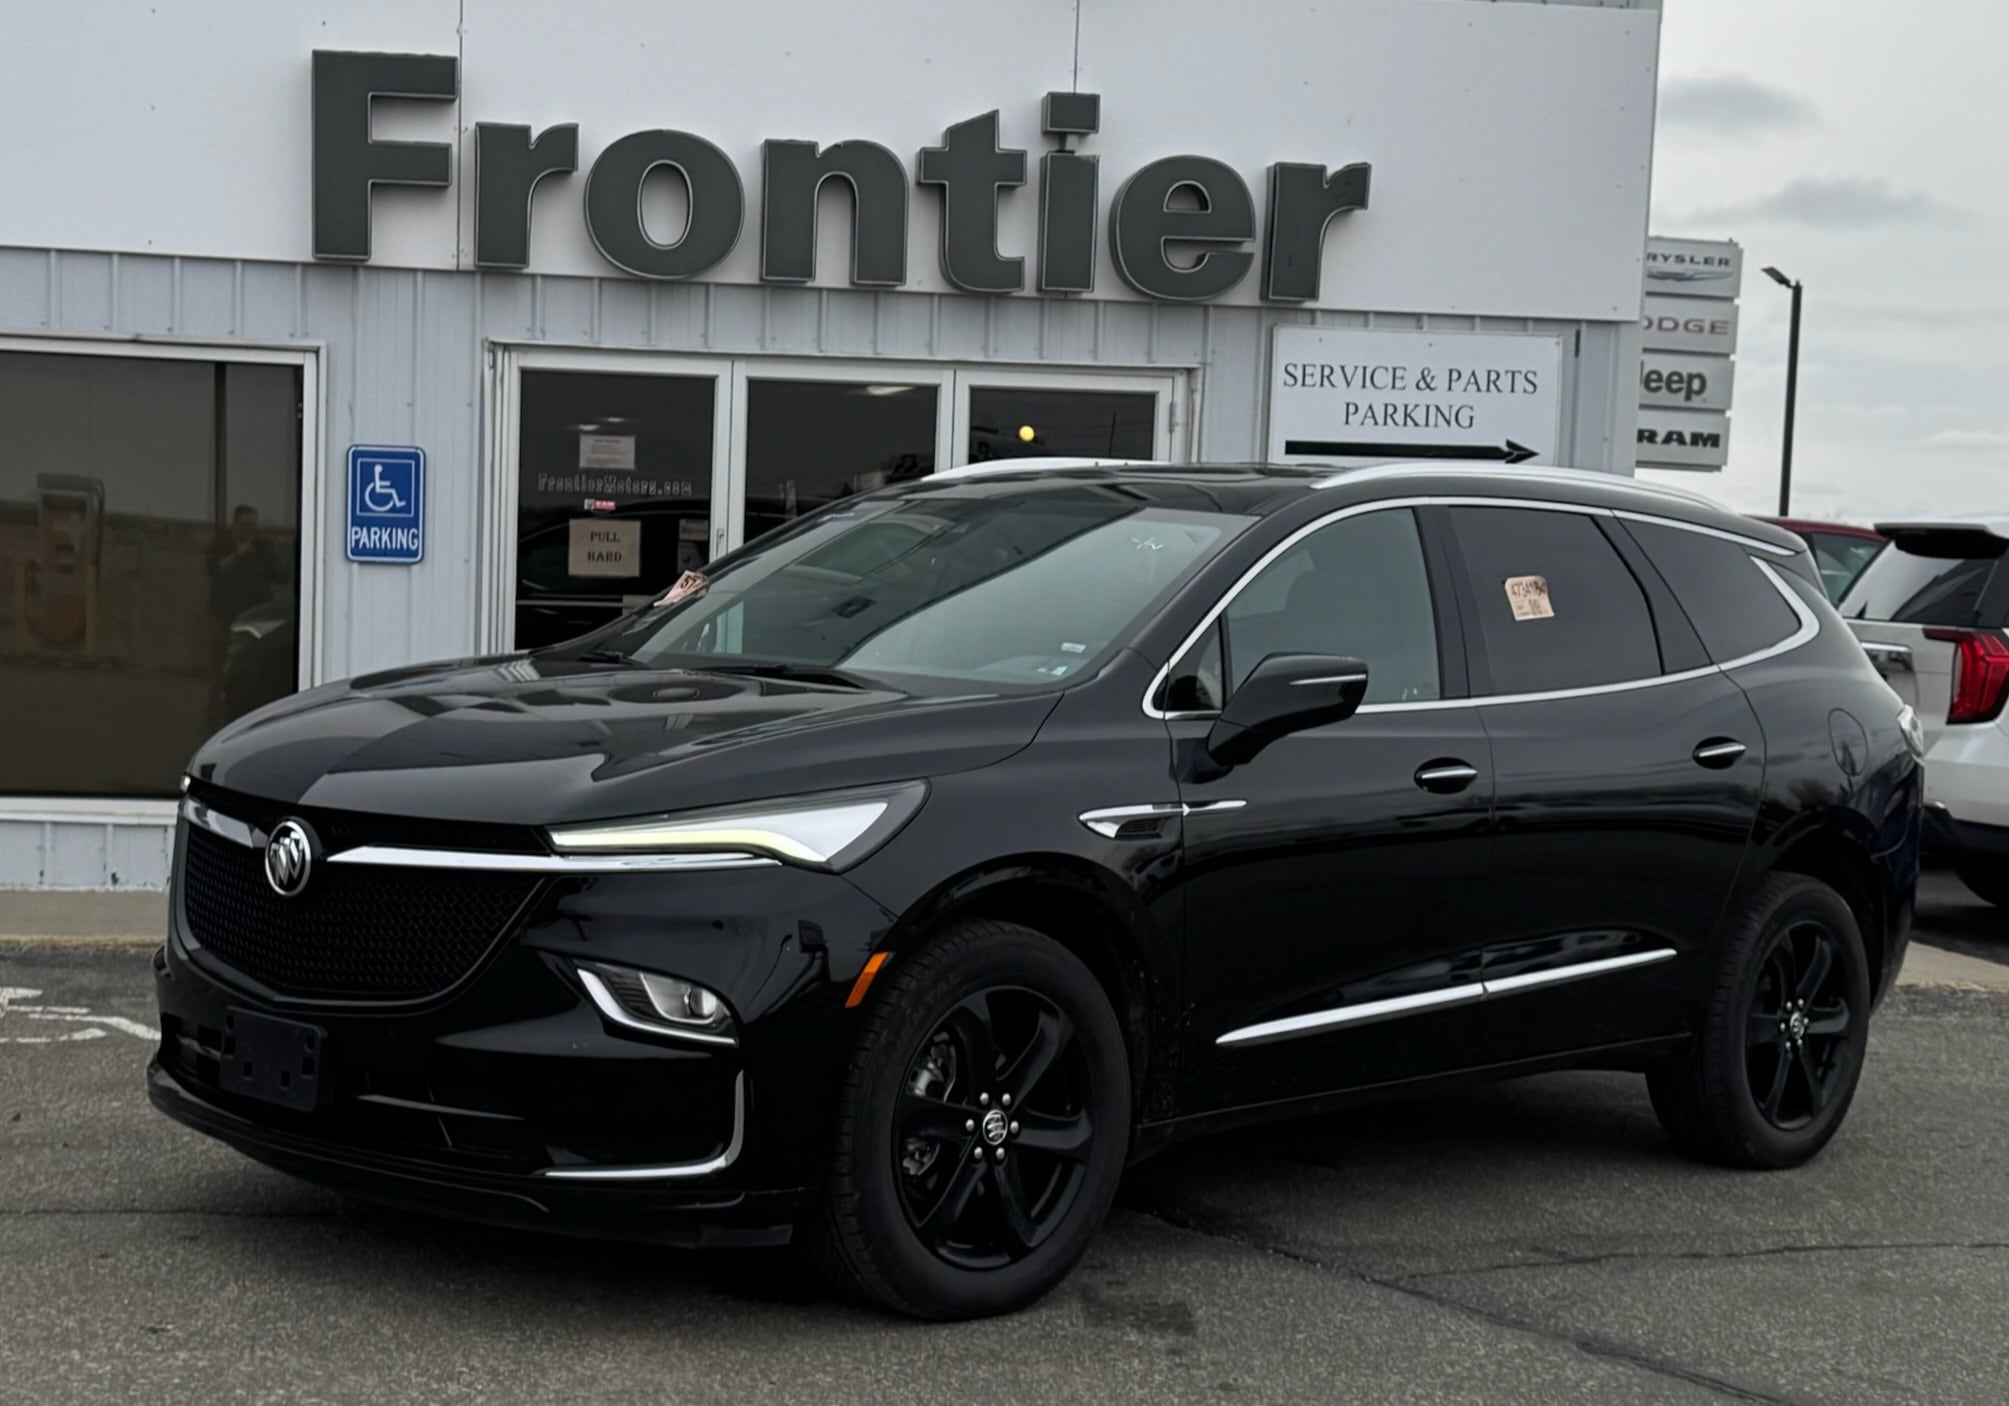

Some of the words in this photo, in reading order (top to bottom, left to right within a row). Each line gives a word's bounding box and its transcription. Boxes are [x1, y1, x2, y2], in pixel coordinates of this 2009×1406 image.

[311, 49, 1372, 302] Frontier
[1283, 363, 1407, 391] SERVICE
[1415, 366, 1438, 393] &
[1447, 368, 1539, 395] PARTS
[1343, 402, 1475, 430] PARKING
[1637, 428, 1721, 449] RAM
[351, 526, 418, 550] PARKING
[590, 530, 622, 543] PULL
[587, 550, 622, 563] HARD
